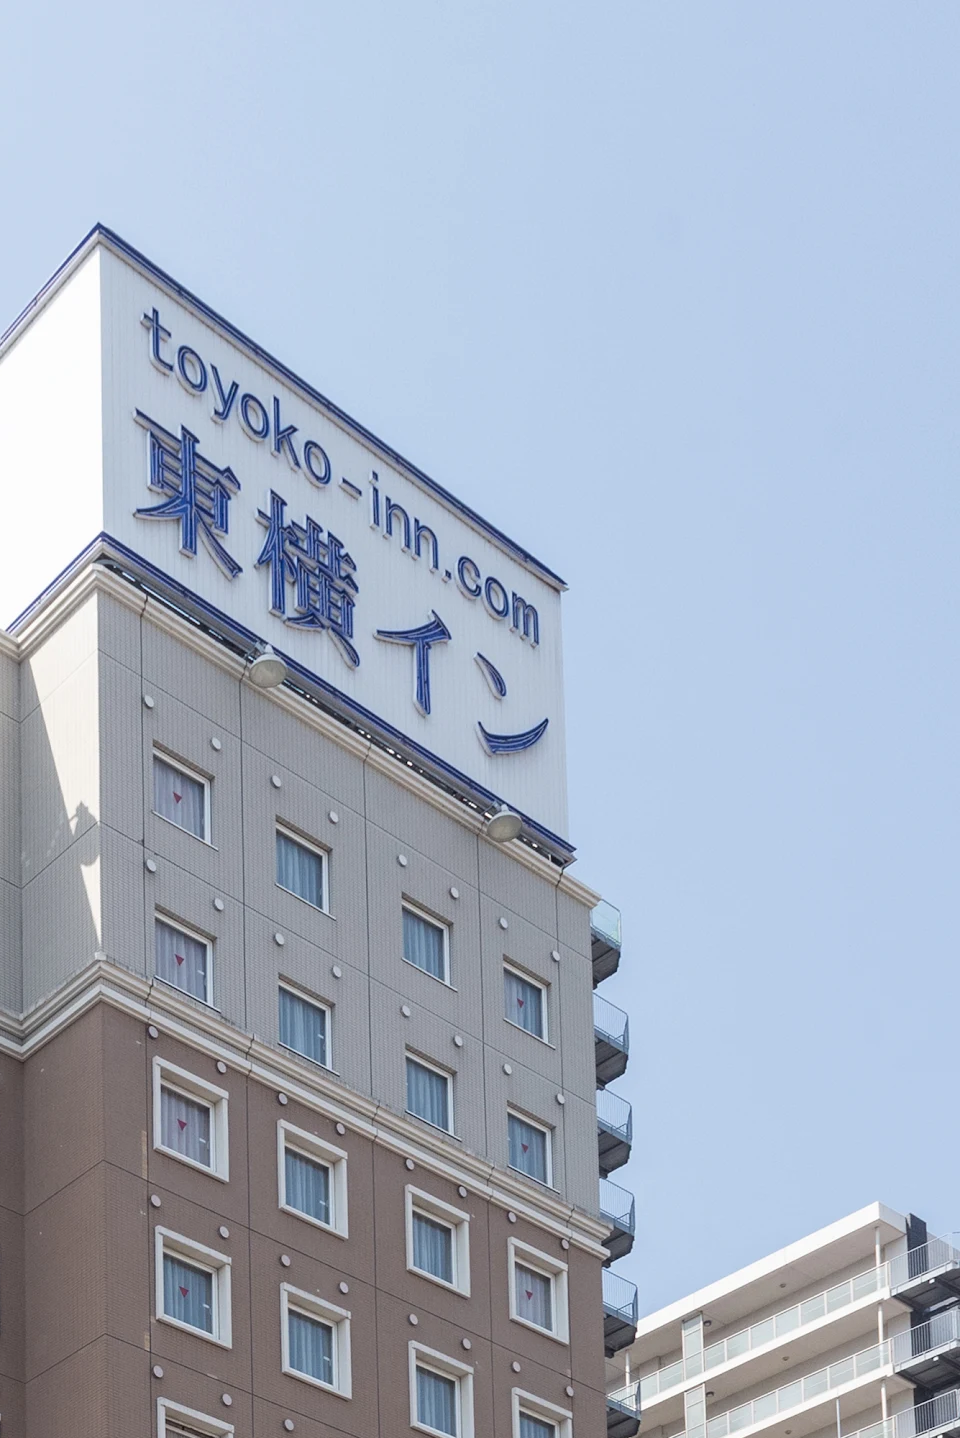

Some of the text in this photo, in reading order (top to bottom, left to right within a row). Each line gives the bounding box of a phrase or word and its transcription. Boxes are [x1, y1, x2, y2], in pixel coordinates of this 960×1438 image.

[132, 406, 549, 757] 東横イン
[140, 306, 540, 648] toyoko-inn.com
